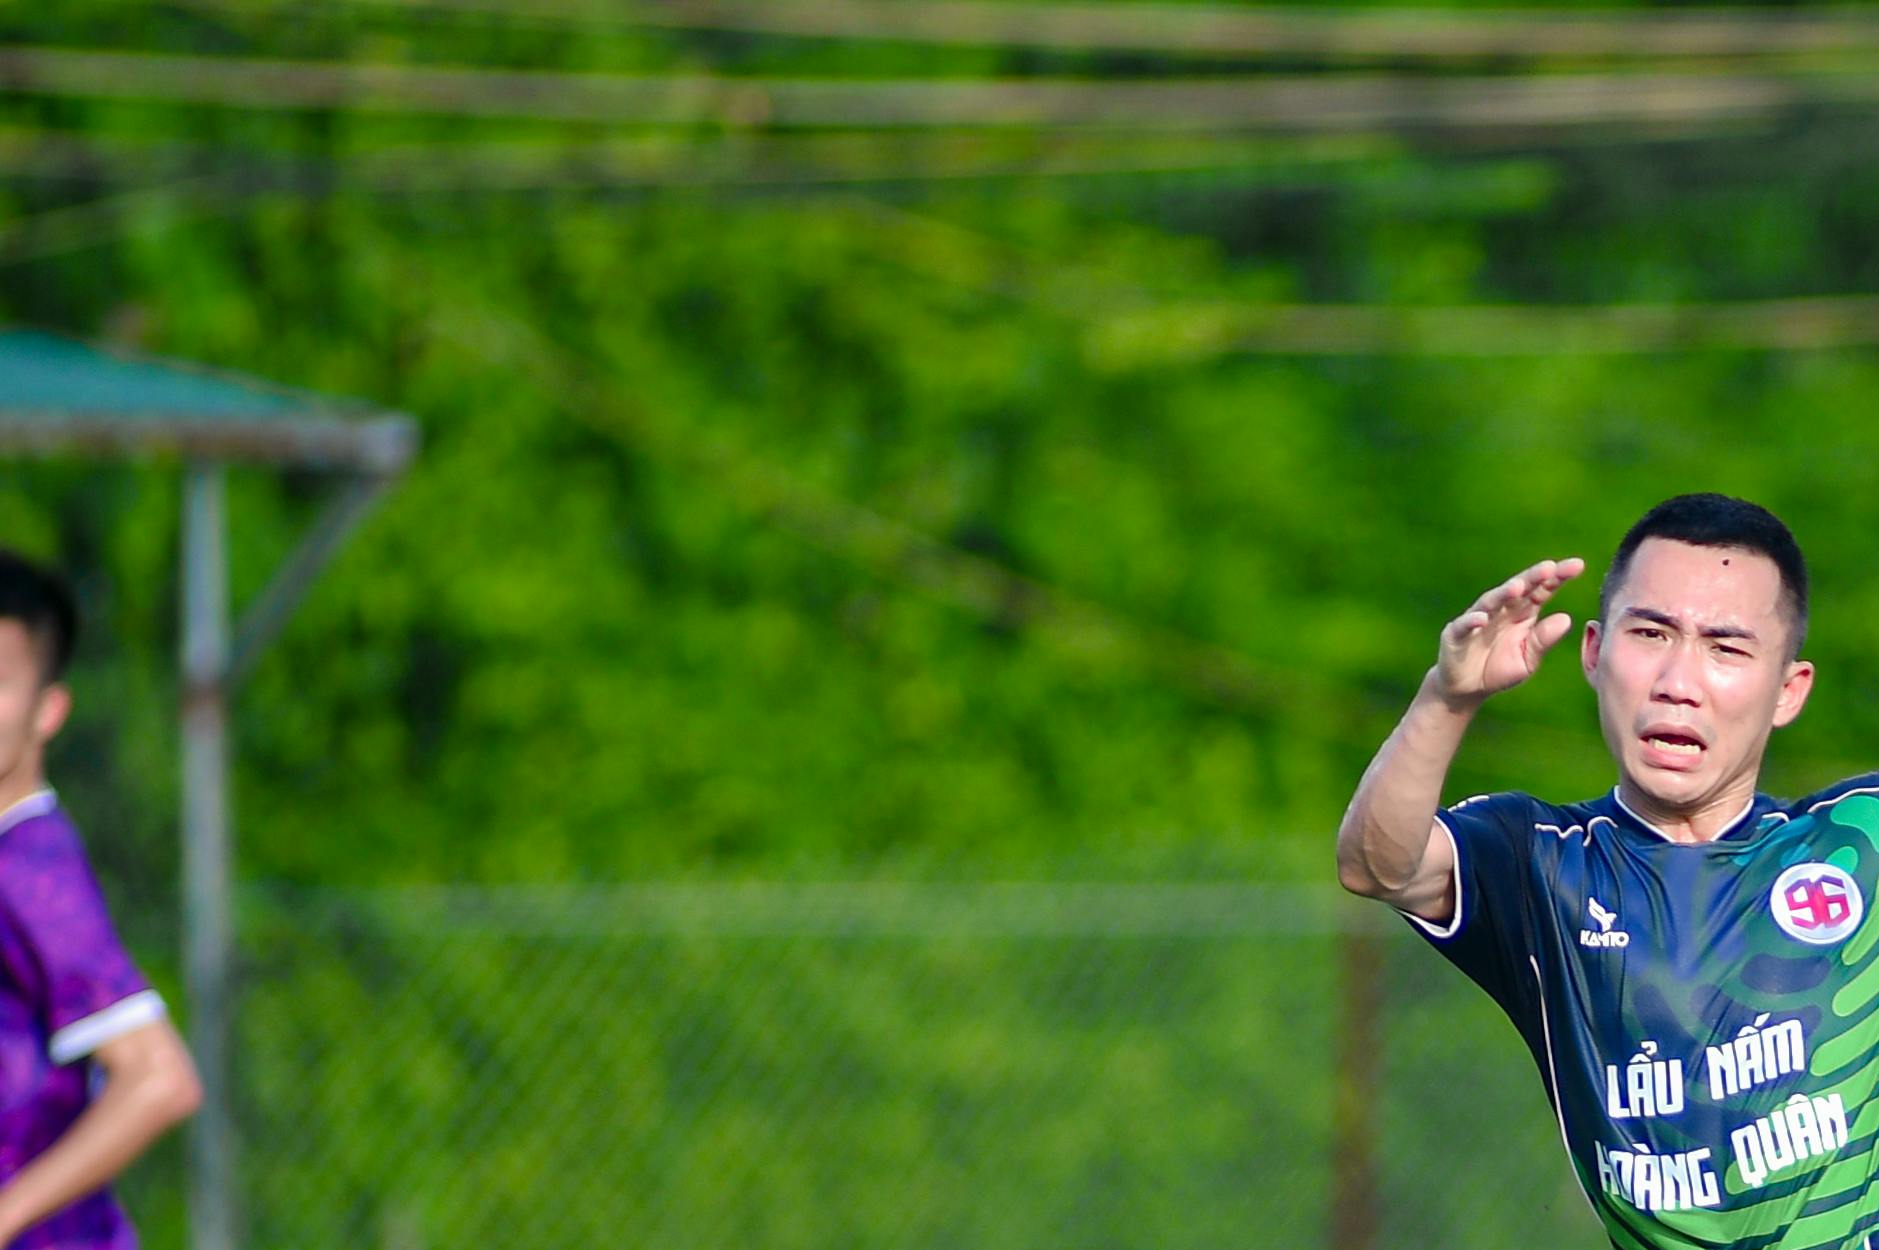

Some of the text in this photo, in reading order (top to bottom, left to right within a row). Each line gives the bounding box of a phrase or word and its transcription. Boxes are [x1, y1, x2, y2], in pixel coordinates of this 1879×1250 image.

[1783, 873, 1851, 930] 96
[1606, 1012, 1805, 1118] LẨU NẤM
[1731, 1093, 1848, 1188] QUÂN
